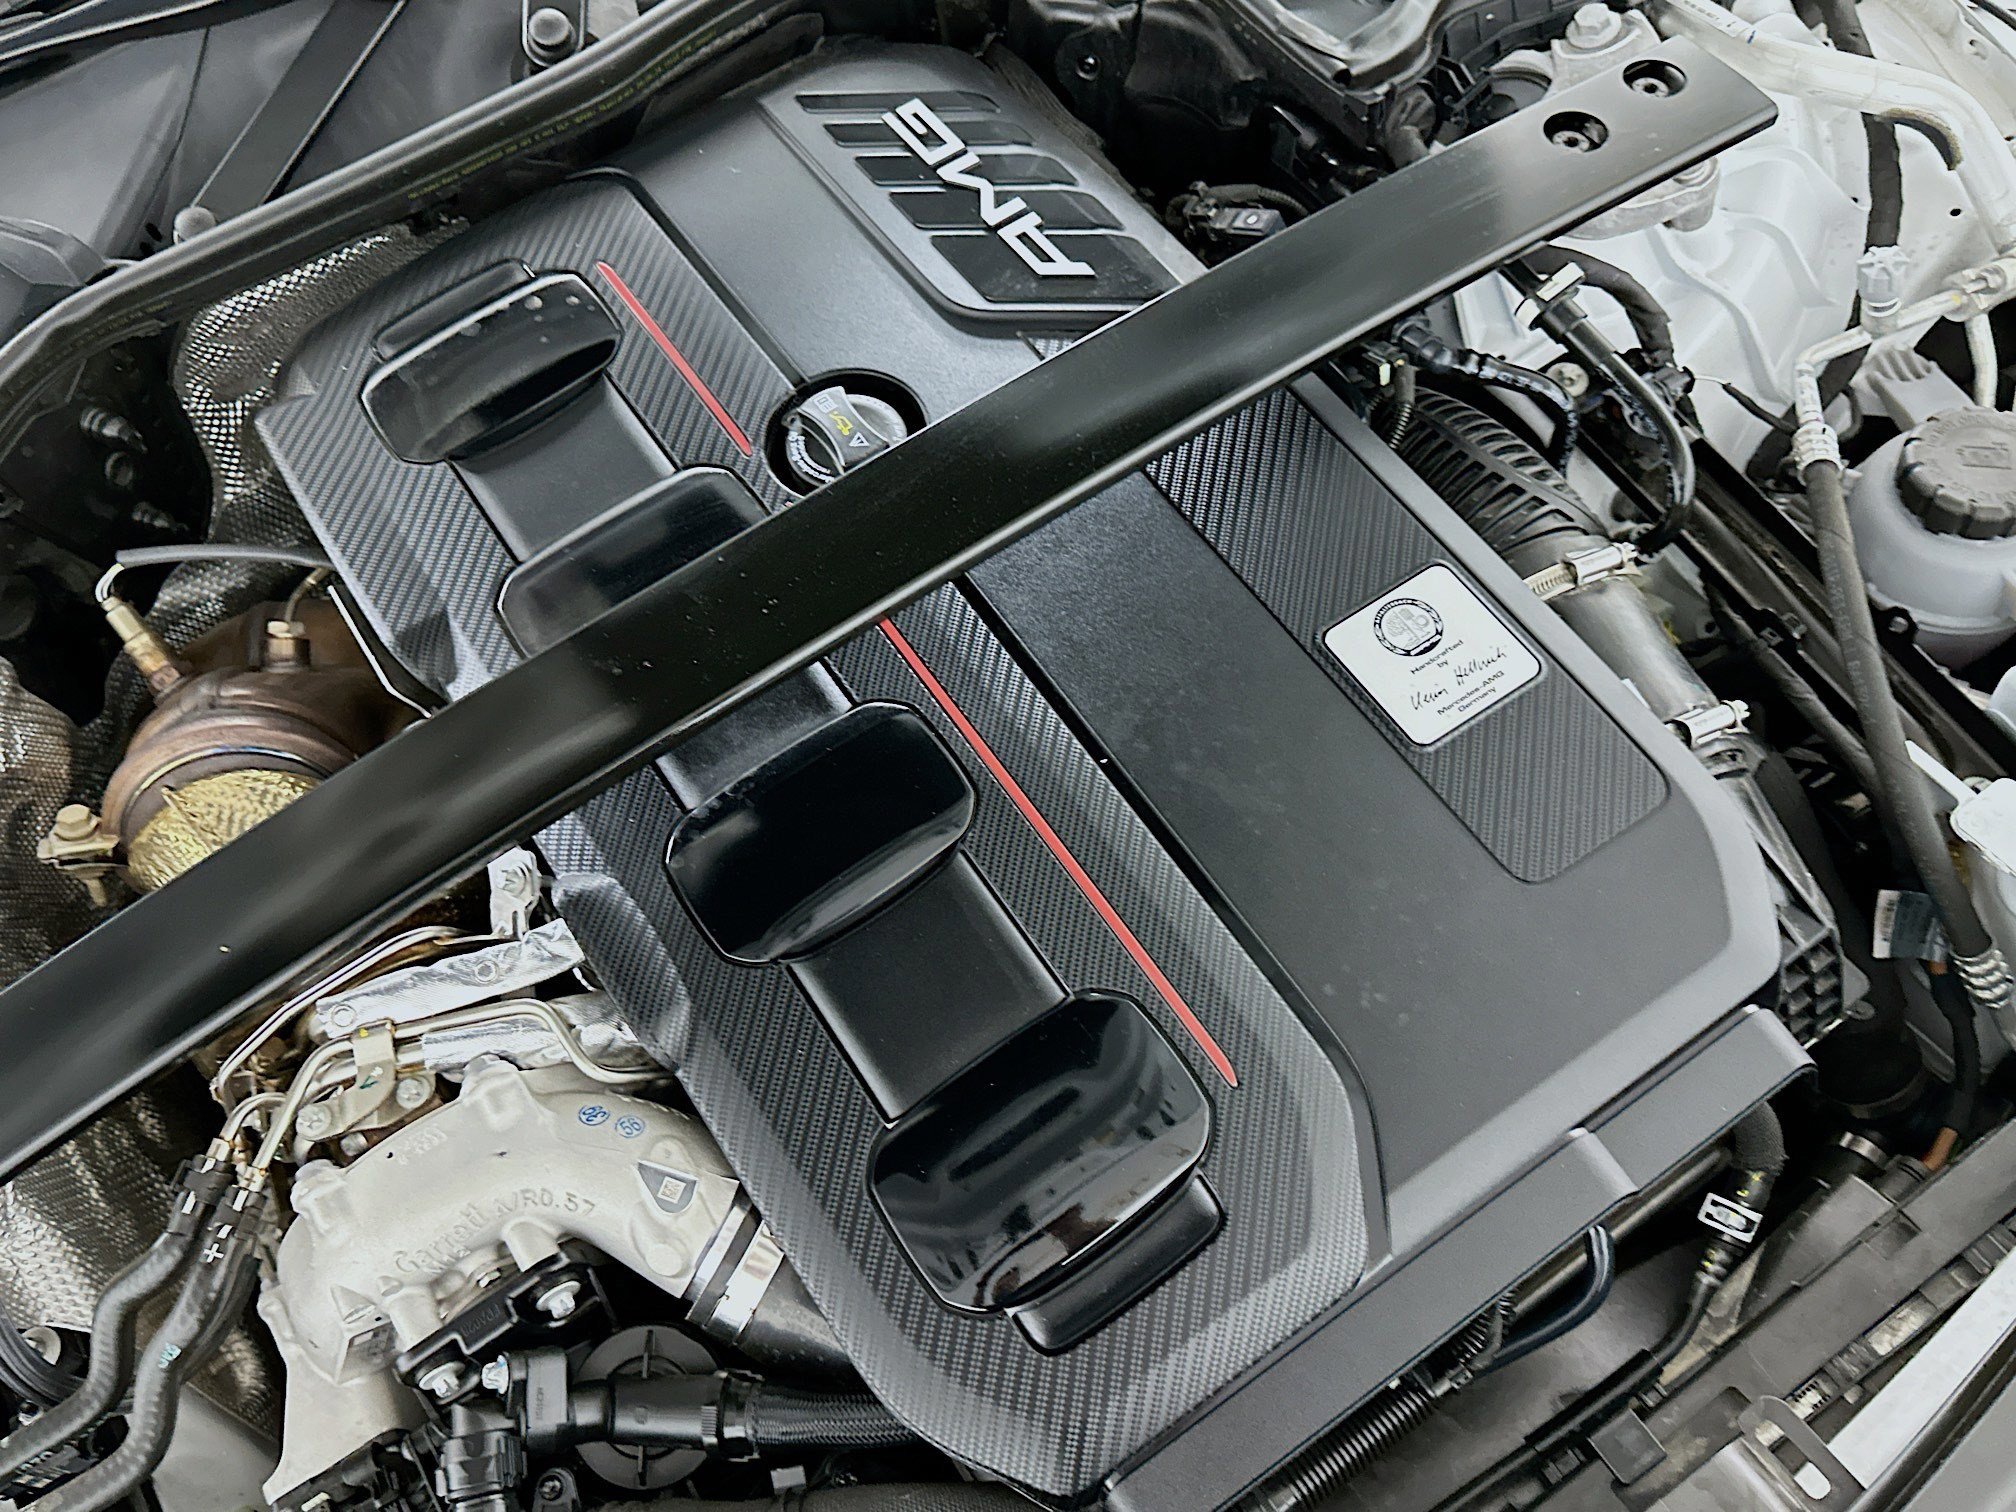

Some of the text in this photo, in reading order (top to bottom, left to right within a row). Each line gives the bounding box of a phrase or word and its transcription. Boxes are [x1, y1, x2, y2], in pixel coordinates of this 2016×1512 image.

[881, 97, 1096, 276] AMG
[1410, 639, 1464, 674] Handcrafted
[1437, 660, 1449, 669] by
[1437, 670, 1505, 715] Mercedes-AMG
[1457, 686, 1497, 712] Germany
[620, 1118, 642, 1136] 56
[393, 1203, 489, 1273] Garrett
